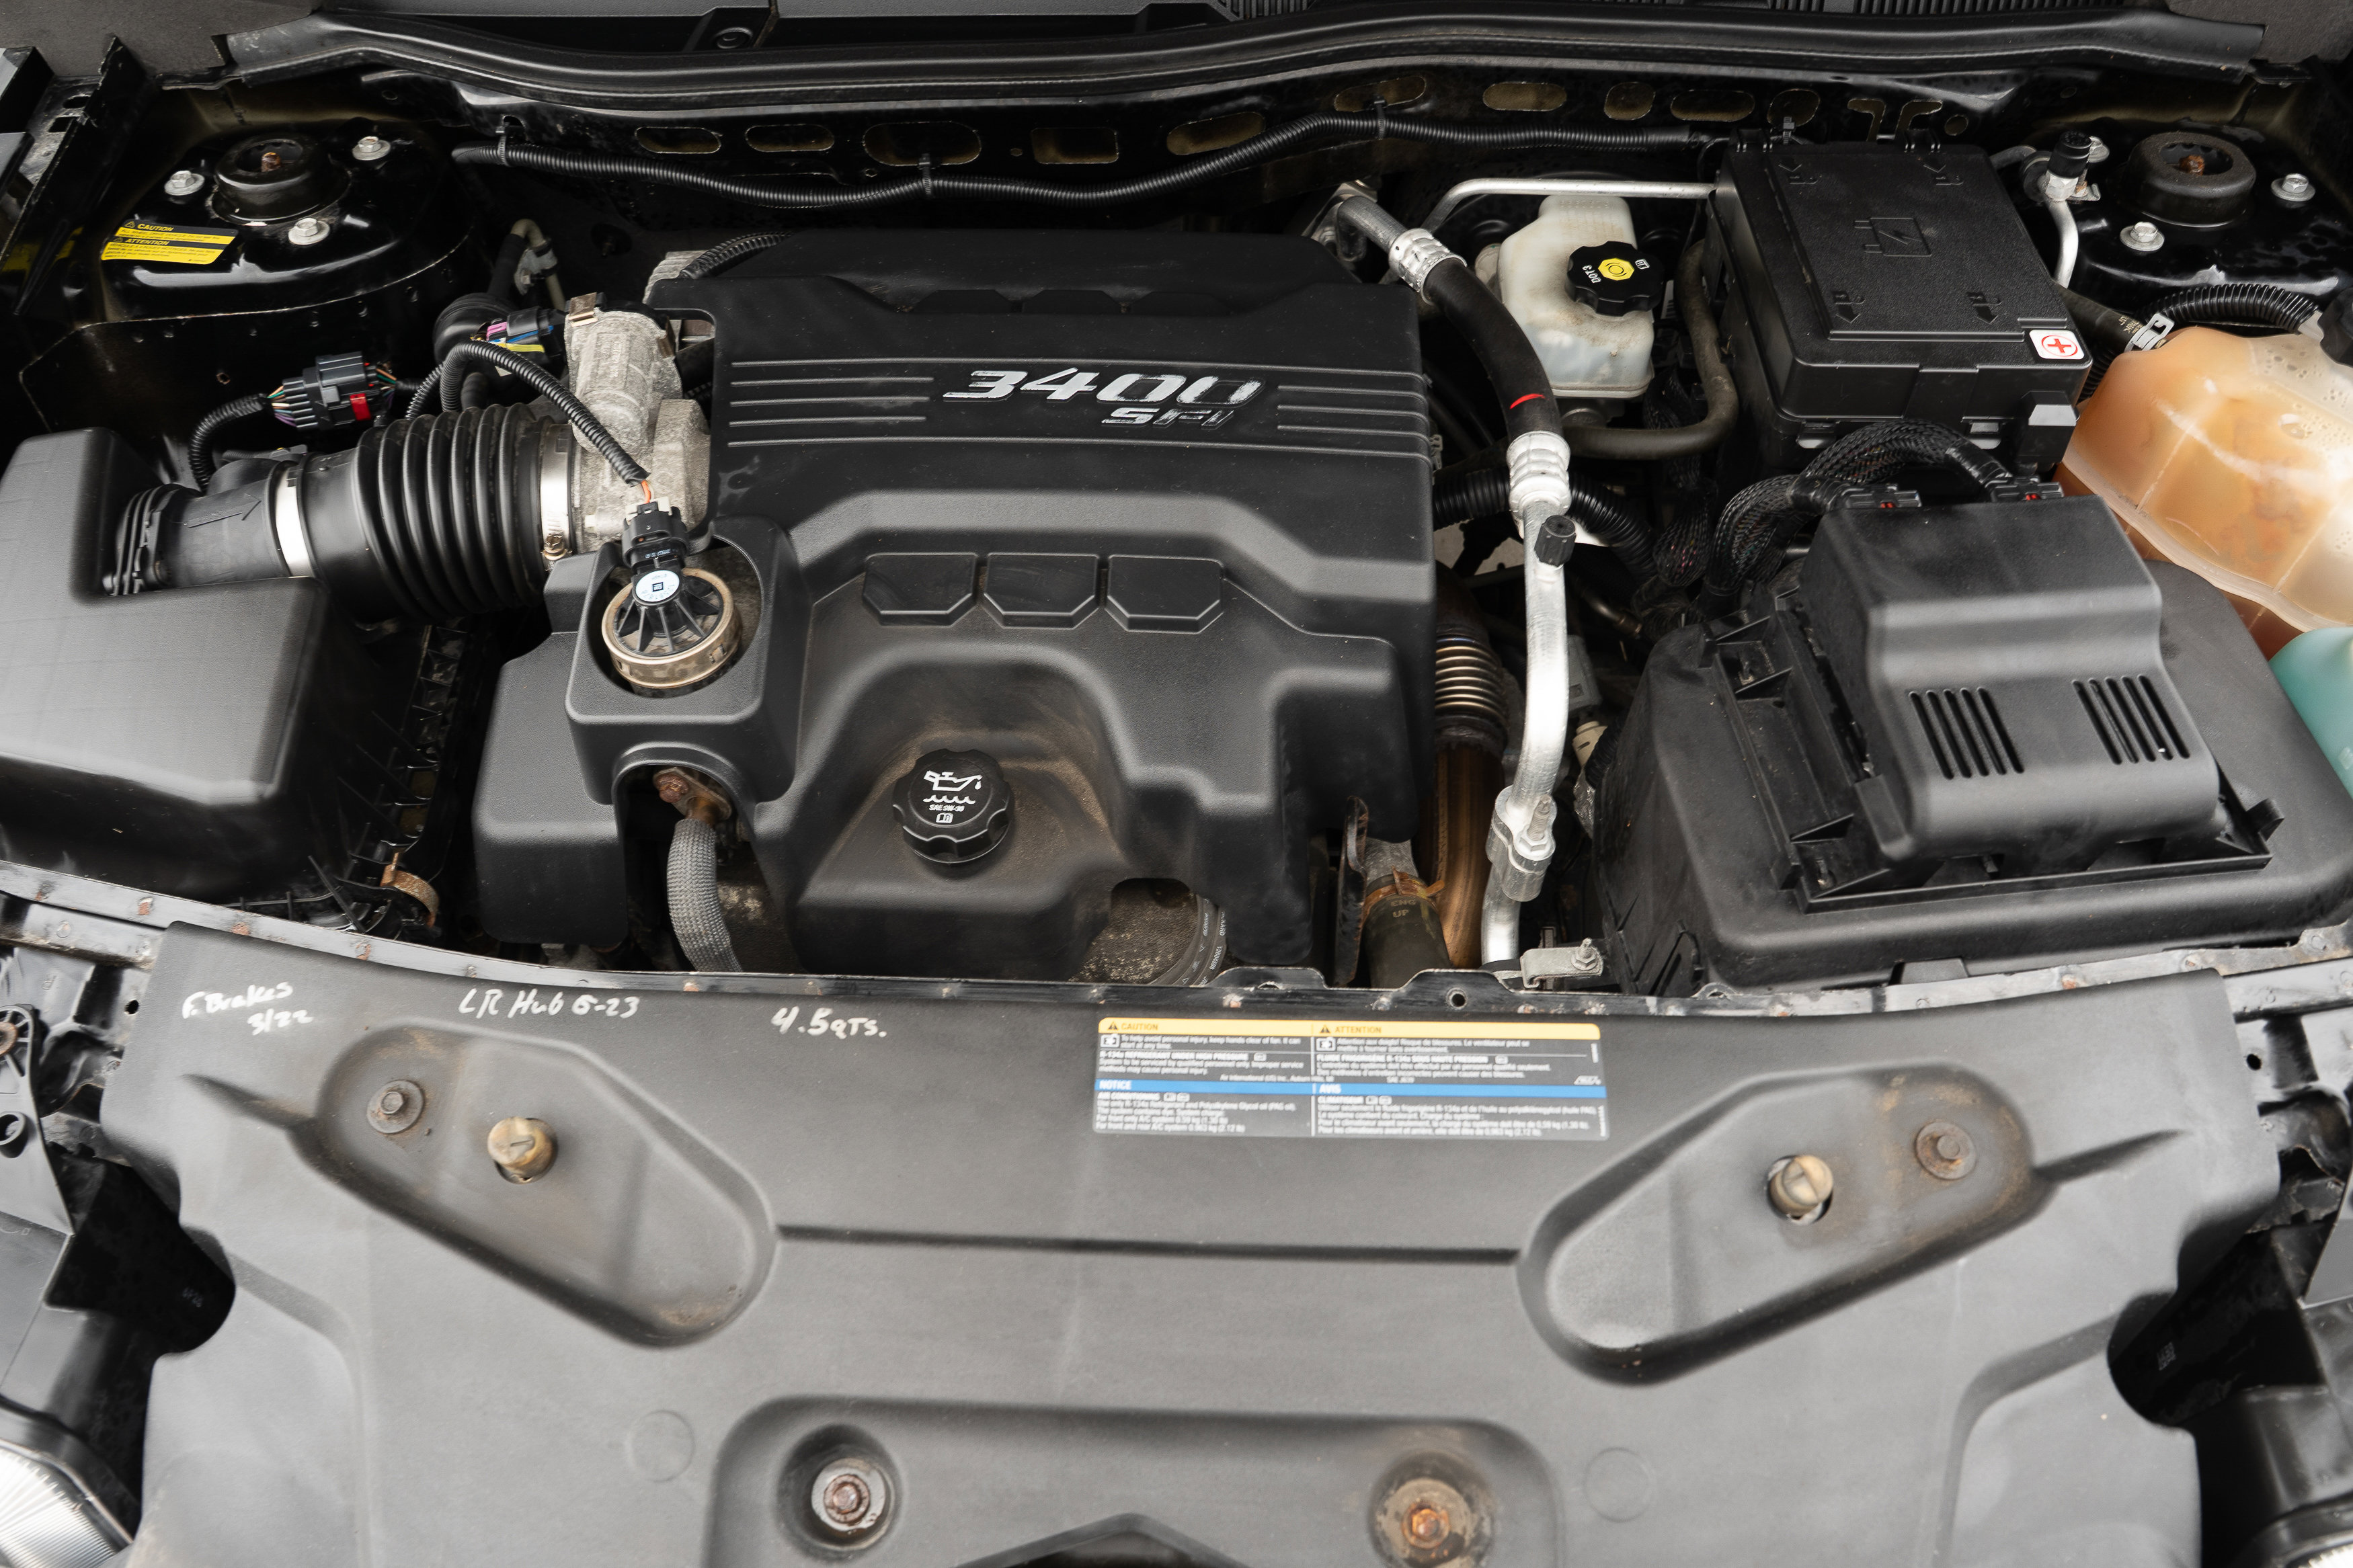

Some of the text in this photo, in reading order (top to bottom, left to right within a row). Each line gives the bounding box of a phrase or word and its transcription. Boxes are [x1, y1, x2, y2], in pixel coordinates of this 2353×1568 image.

[137, 223, 174, 232] CAUTION
[943, 368, 1264, 405] 3400
[1392, 909, 1409, 918] UP
[204, 982, 293, 1014] Brakes
[458, 988, 503, 1019] LR
[508, 988, 565, 1019] Hub
[247, 1008, 314, 1036] 3/22
[1099, 1080, 1131, 1089] NOTICE
[1319, 1084, 1341, 1094] AVIS
